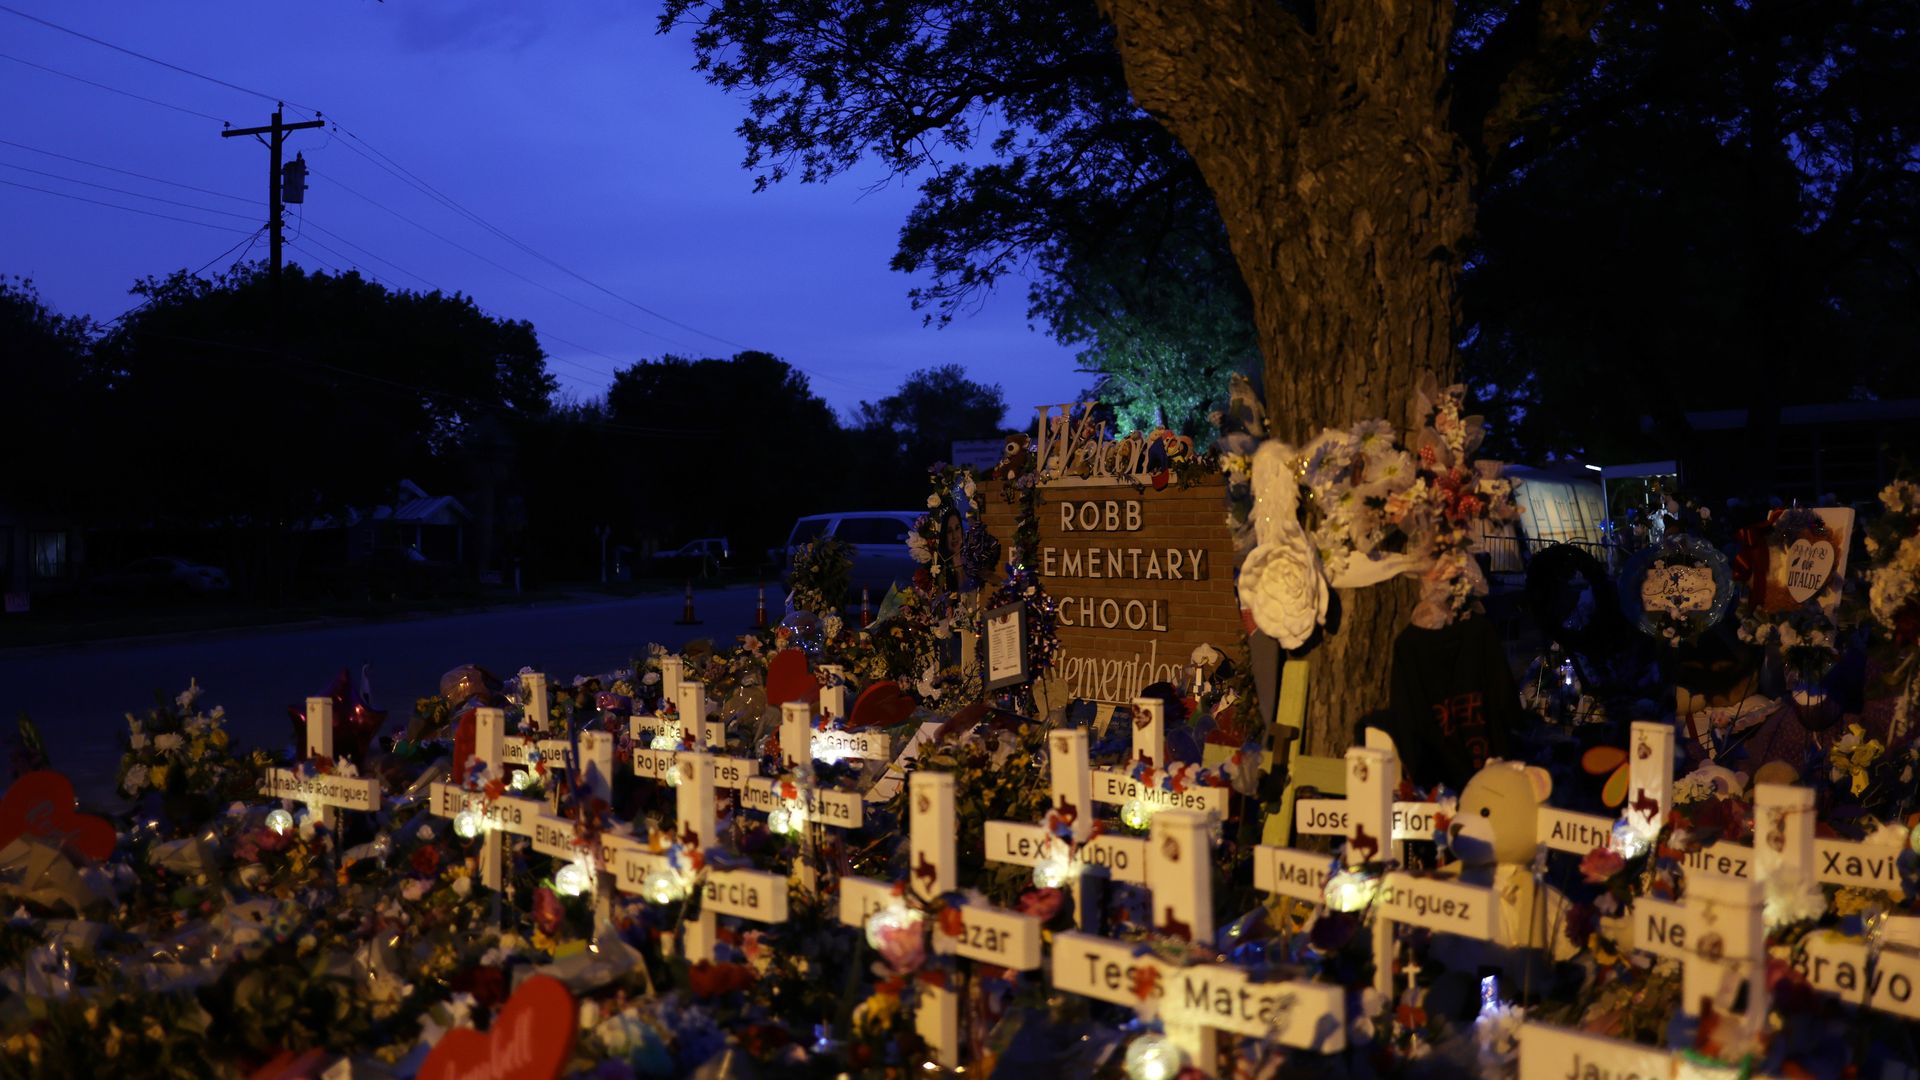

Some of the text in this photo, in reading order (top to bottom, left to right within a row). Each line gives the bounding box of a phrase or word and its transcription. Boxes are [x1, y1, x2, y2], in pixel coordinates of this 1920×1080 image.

[1061, 500, 1143, 532] ROBB
[1009, 546, 1204, 581] EMENTARY
[1788, 571, 1822, 590] UVALDE
[1058, 597, 1167, 632] CHOOL
[1053, 638, 1183, 702] ienvenidos
[827, 735, 868, 752] Garcia
[714, 765, 739, 782] res
[315, 782, 369, 802] Rodriguez
[1108, 779, 1206, 811] Eva Mireles
[487, 805, 521, 825] arcia
[808, 798, 849, 819] Garza
[1306, 808, 1433, 831] Jose Flor
[1551, 821, 1610, 848] Alithi
[1006, 833, 1128, 870] Lex ubio
[1822, 850, 1894, 881] Xavi
[705, 877, 759, 909] arcia
[1279, 866, 1471, 921] Mait driguez
[957, 924, 1011, 953] azar
[1184, 976, 1277, 1024] Mata
